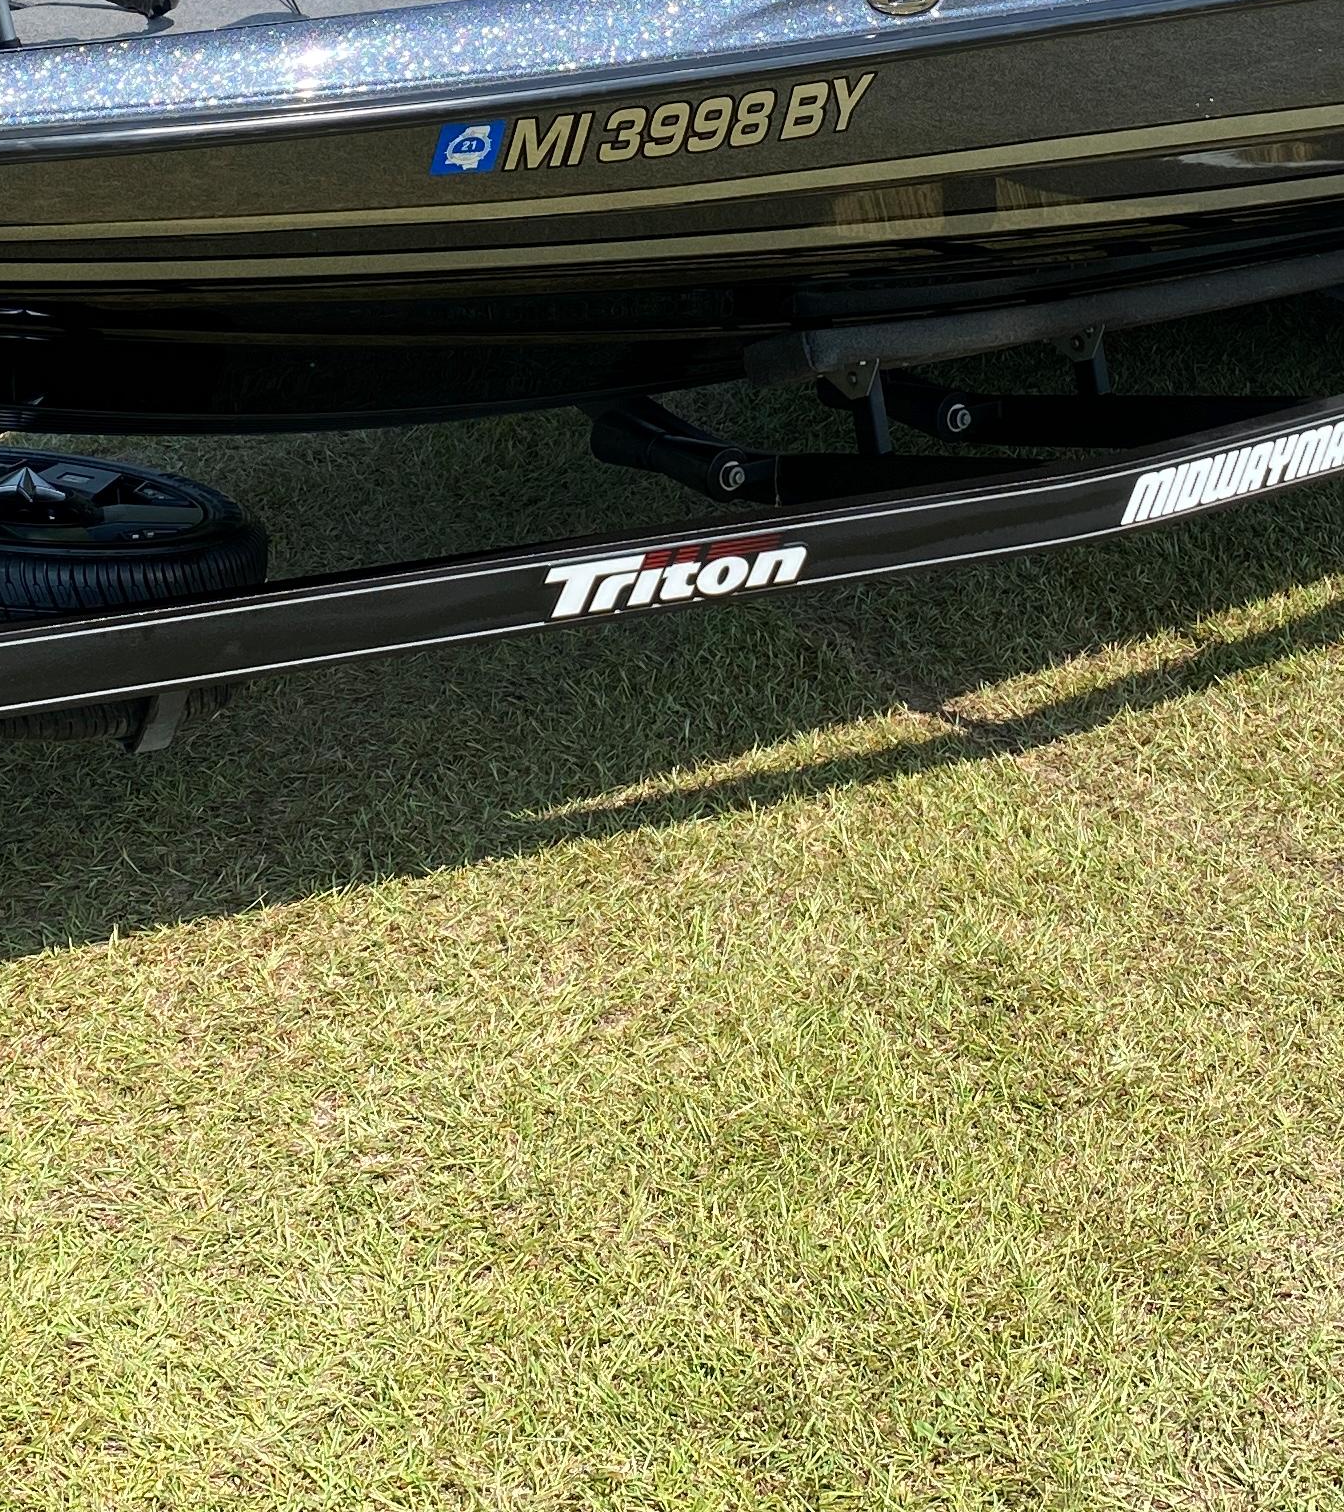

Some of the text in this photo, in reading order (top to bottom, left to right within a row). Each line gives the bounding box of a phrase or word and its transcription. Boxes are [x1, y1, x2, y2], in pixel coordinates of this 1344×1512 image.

[461, 140, 477, 151] 21
[503, 71, 876, 171] MI 3998 BY
[544, 540, 808, 619] Triton
